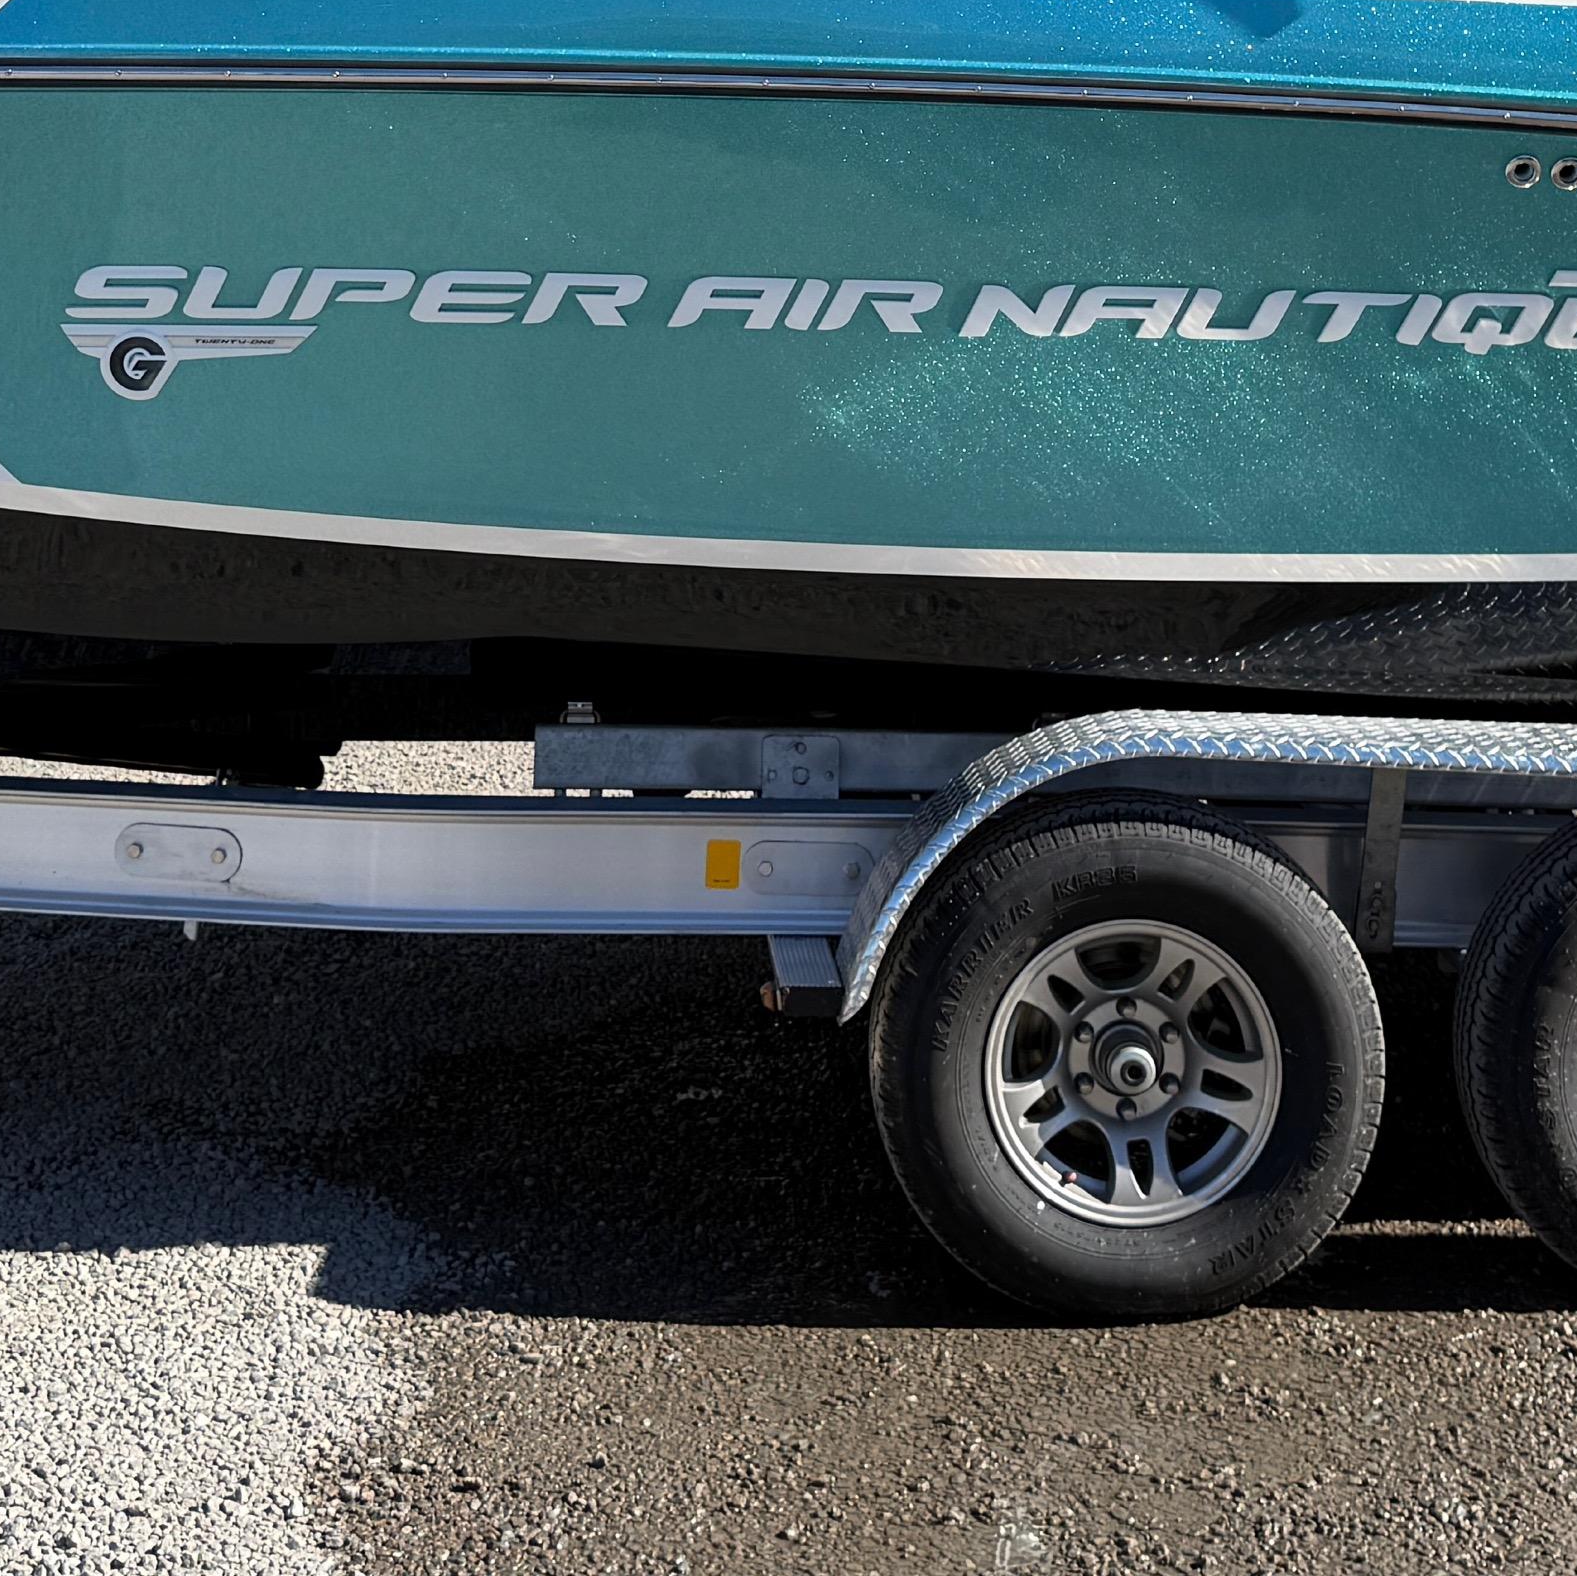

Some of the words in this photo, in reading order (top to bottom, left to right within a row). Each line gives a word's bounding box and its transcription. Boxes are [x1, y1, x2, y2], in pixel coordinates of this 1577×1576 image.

[65, 265, 649, 326] SUPER
[667, 276, 943, 332] AIR
[931, 898, 1035, 1052] KARRIER
